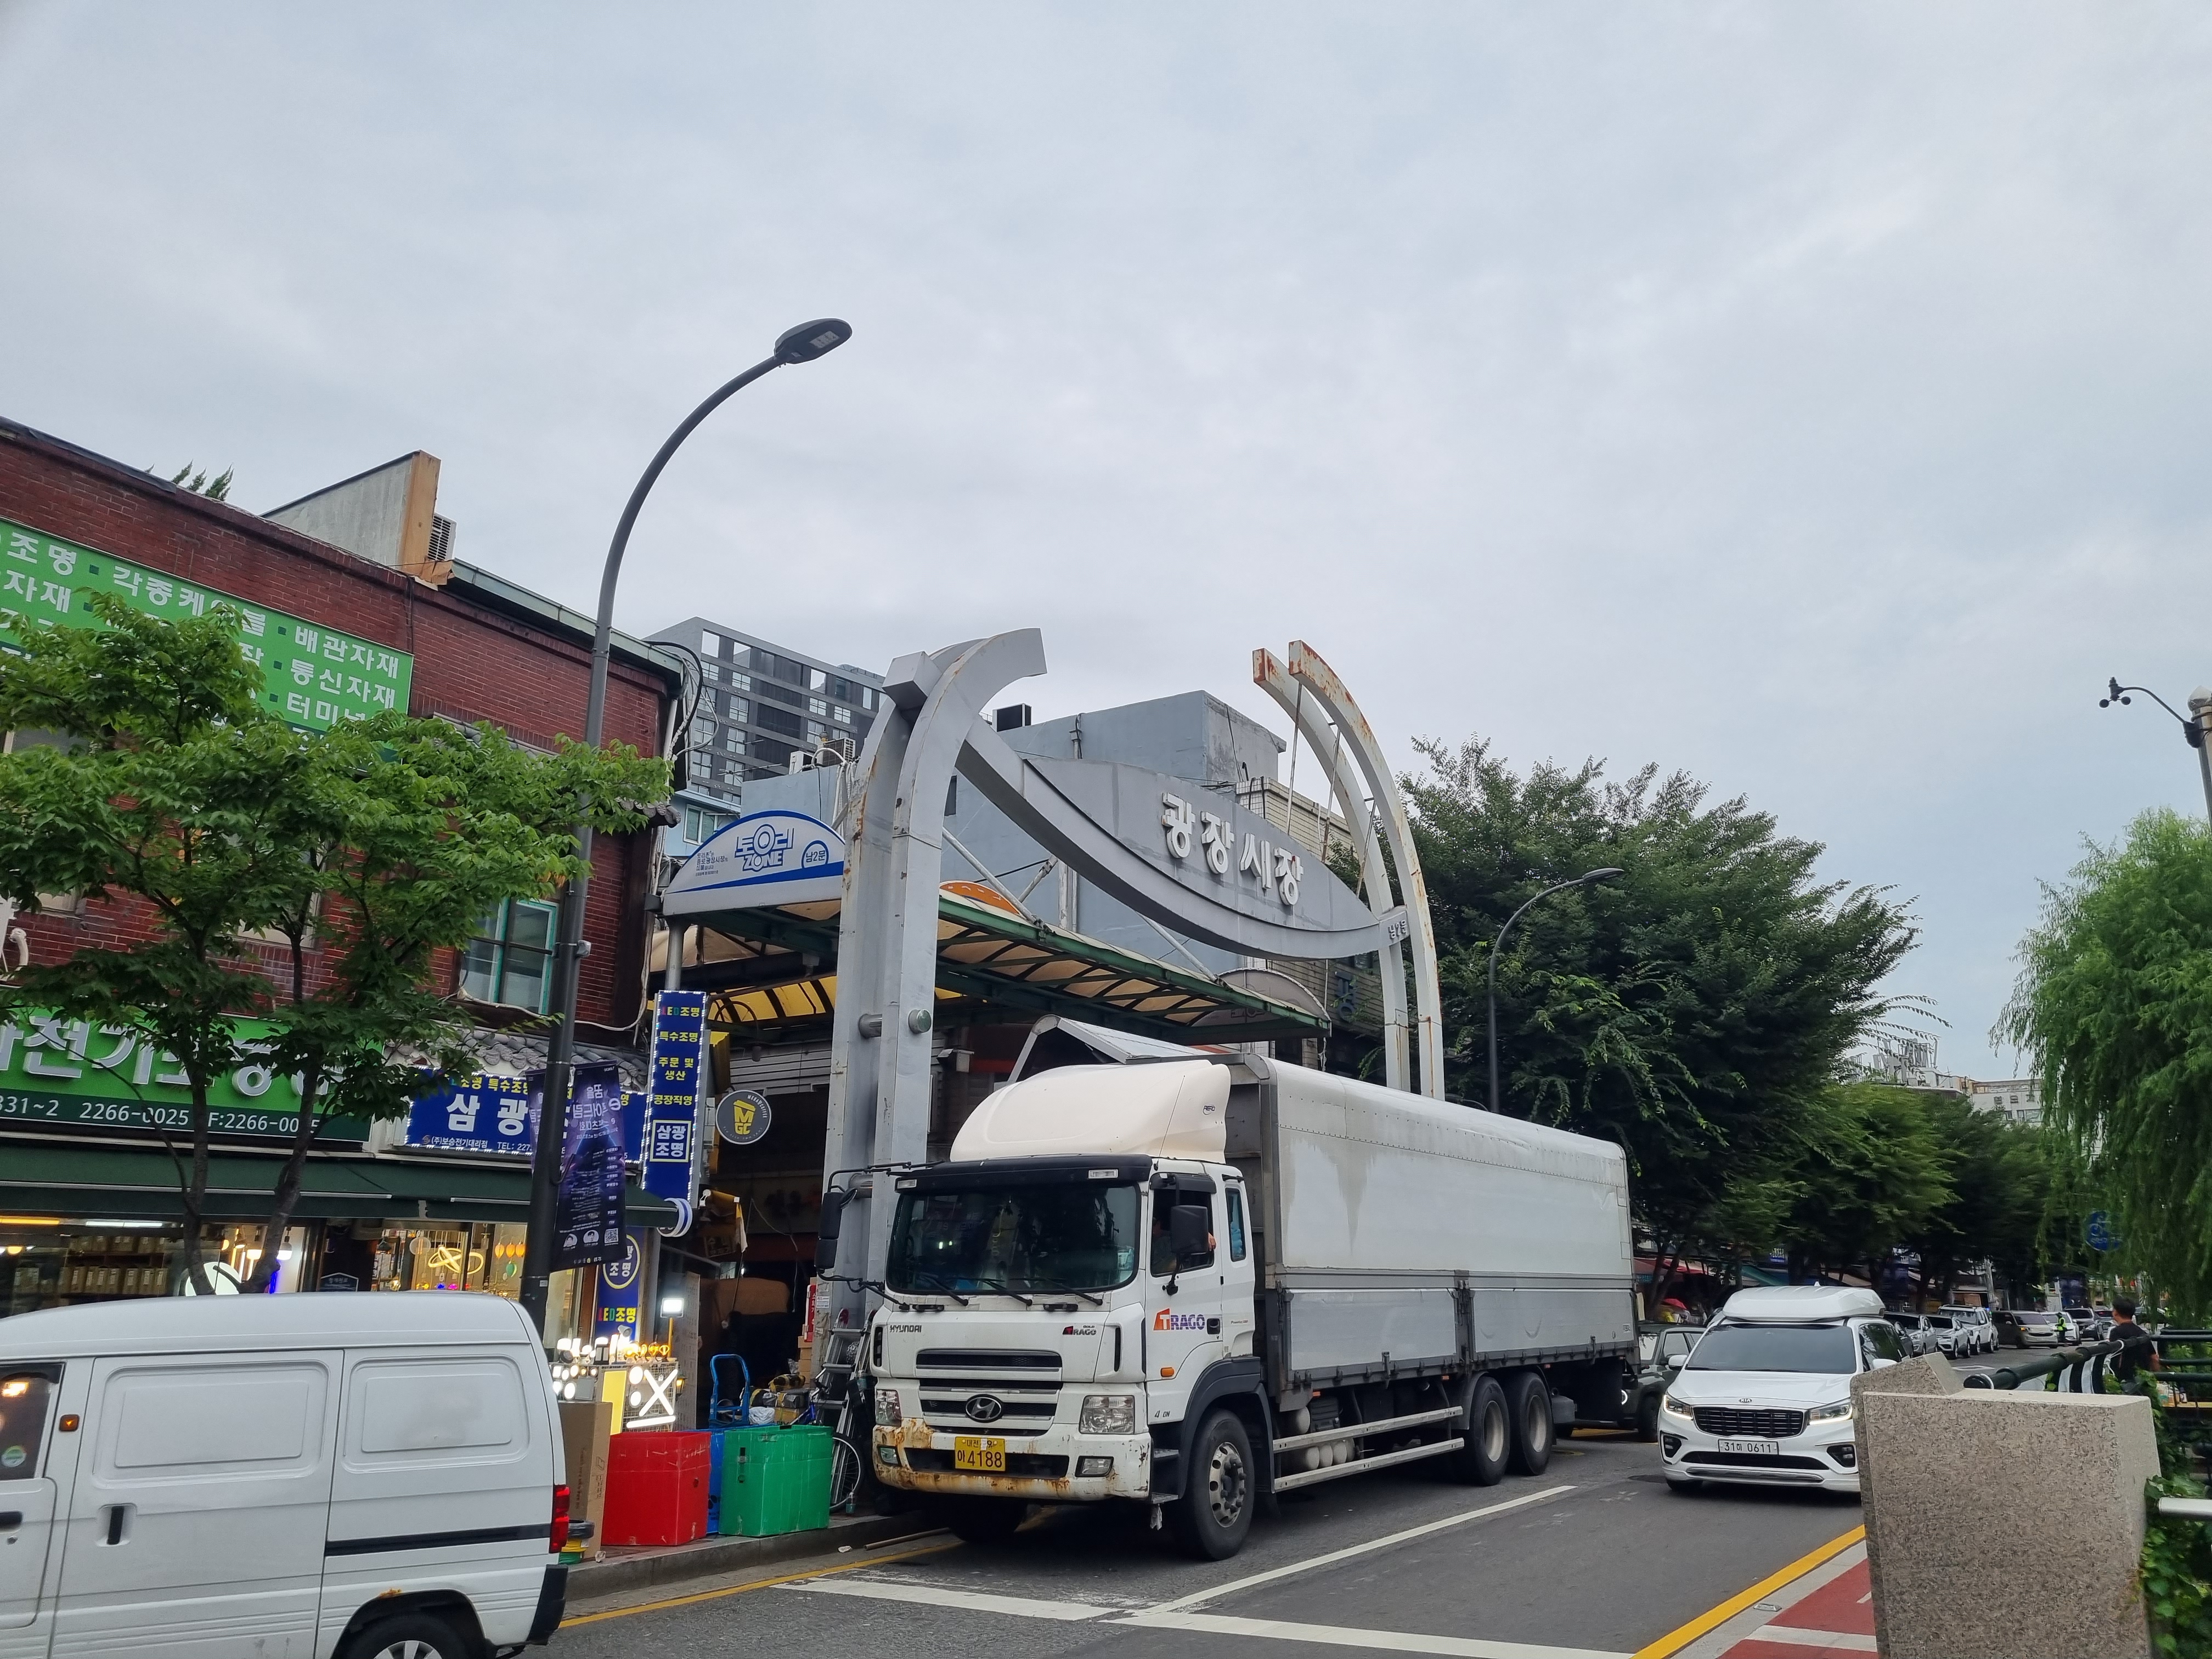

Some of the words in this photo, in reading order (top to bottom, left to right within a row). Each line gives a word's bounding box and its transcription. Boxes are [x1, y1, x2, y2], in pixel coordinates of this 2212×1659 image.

[295, 626, 399, 679] 배관자재
[291, 659, 395, 709] 통신자재
[1162, 792, 1304, 905] 광장시장
[743, 850, 783, 872] ZONE
[806, 850, 826, 863] 남2문
[662, 1006, 699, 1017] LED조명
[659, 1031, 698, 1043] 특수조명
[658, 1057, 679, 1068] 주문
[685, 1057, 694, 1069] 및
[664, 1070, 686, 1081] 생산
[653, 1094, 692, 1106] 공장직영
[80, 1102, 189, 1126] 2266-0025
[208, 1111, 320, 1134] F:2266-005
[446, 1093, 528, 1136] 삼광
[656, 1125, 686, 1140] 삼광
[497, 1142, 515, 1150] TEL:
[517, 1143, 533, 1152] 227
[655, 1142, 684, 1158] 조명
[609, 1262, 631, 1277] 조명
[598, 1307, 637, 1323] LED조명
[1154, 1310, 1205, 1330] TRAGO
[1747, 1443, 1771, 1453] 0611
